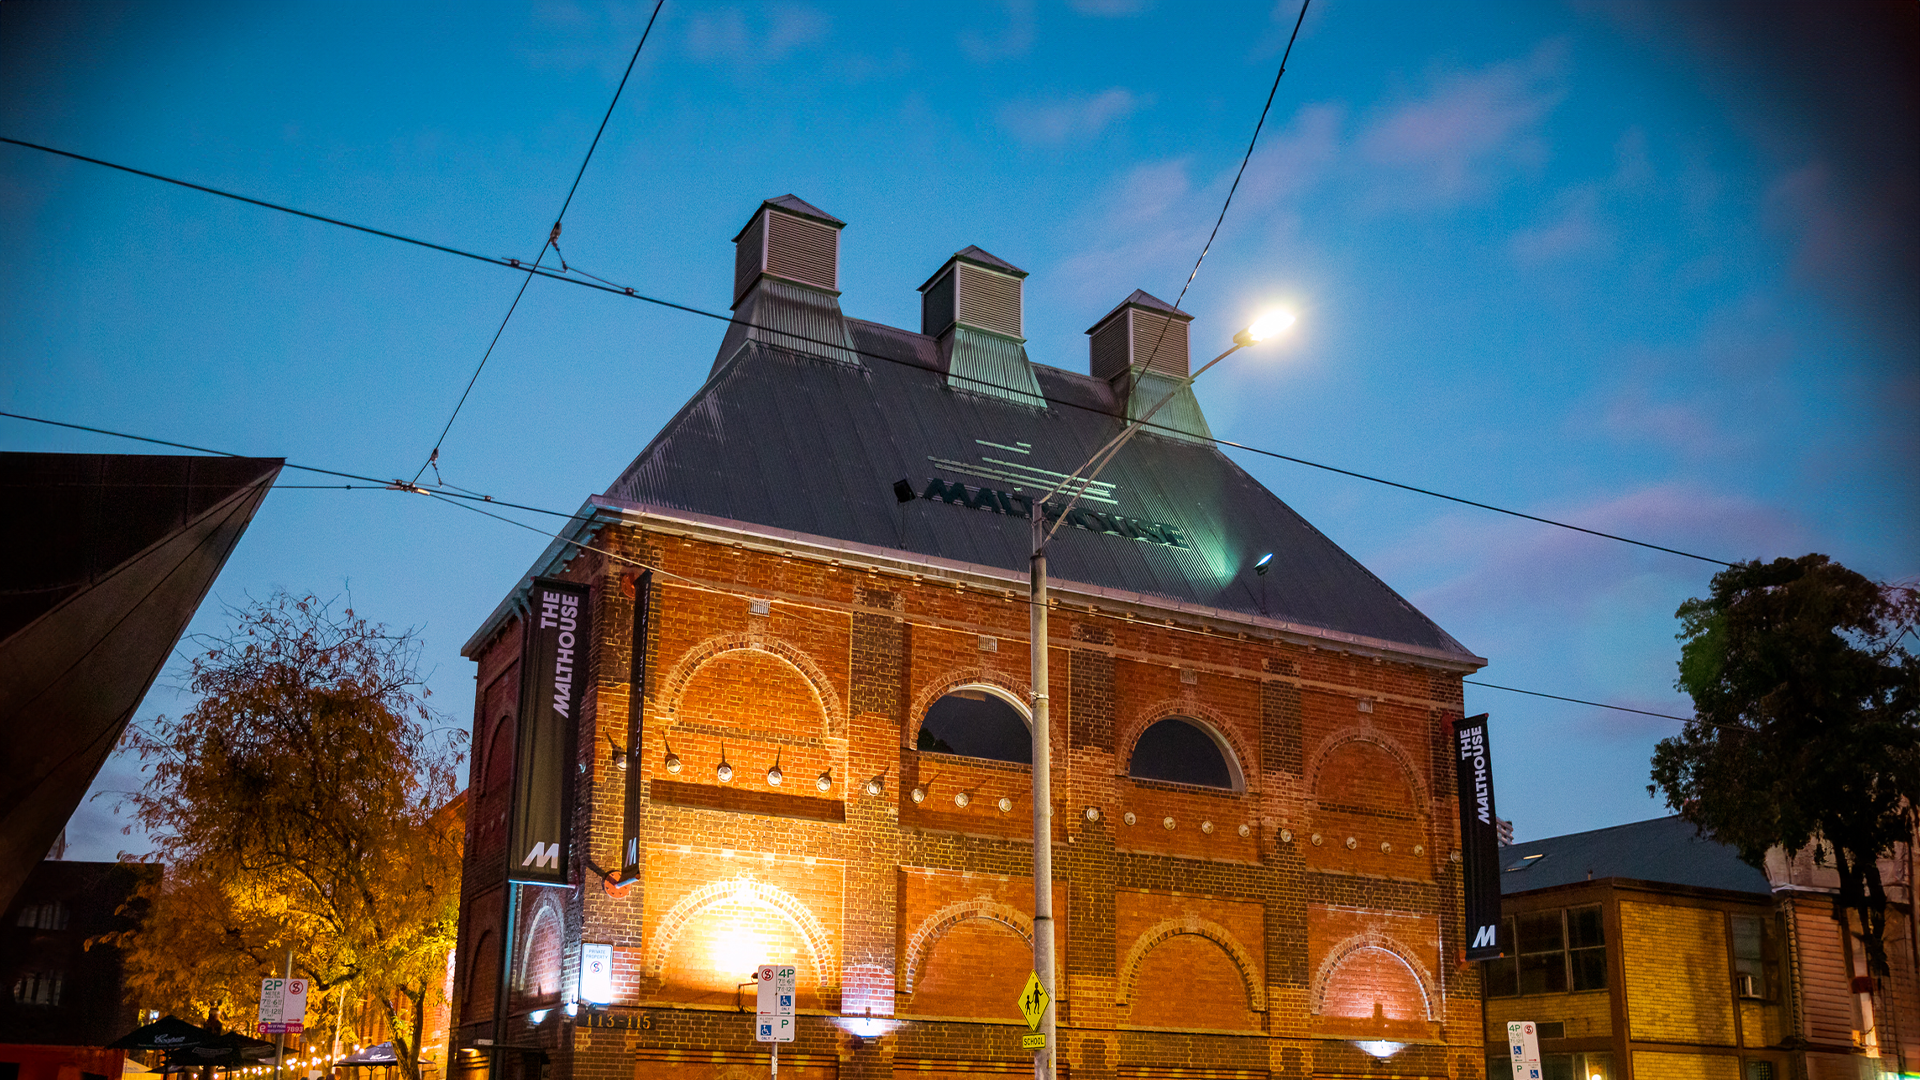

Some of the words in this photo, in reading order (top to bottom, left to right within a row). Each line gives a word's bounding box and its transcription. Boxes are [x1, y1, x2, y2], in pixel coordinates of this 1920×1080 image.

[540, 591, 560, 629] THE
[553, 594, 579, 719] MALTHOUSE
[1460, 728, 1472, 761] THE
[1471, 725, 1491, 825] MALTHOUSE
[778, 969, 795, 979] 4P
[264, 980, 283, 991] 2P
[781, 1019, 789, 1029] P
[1508, 1024, 1521, 1032] 4P
[1023, 1036, 1044, 1046] SCHOOL
[1516, 1064, 1523, 1073] P
